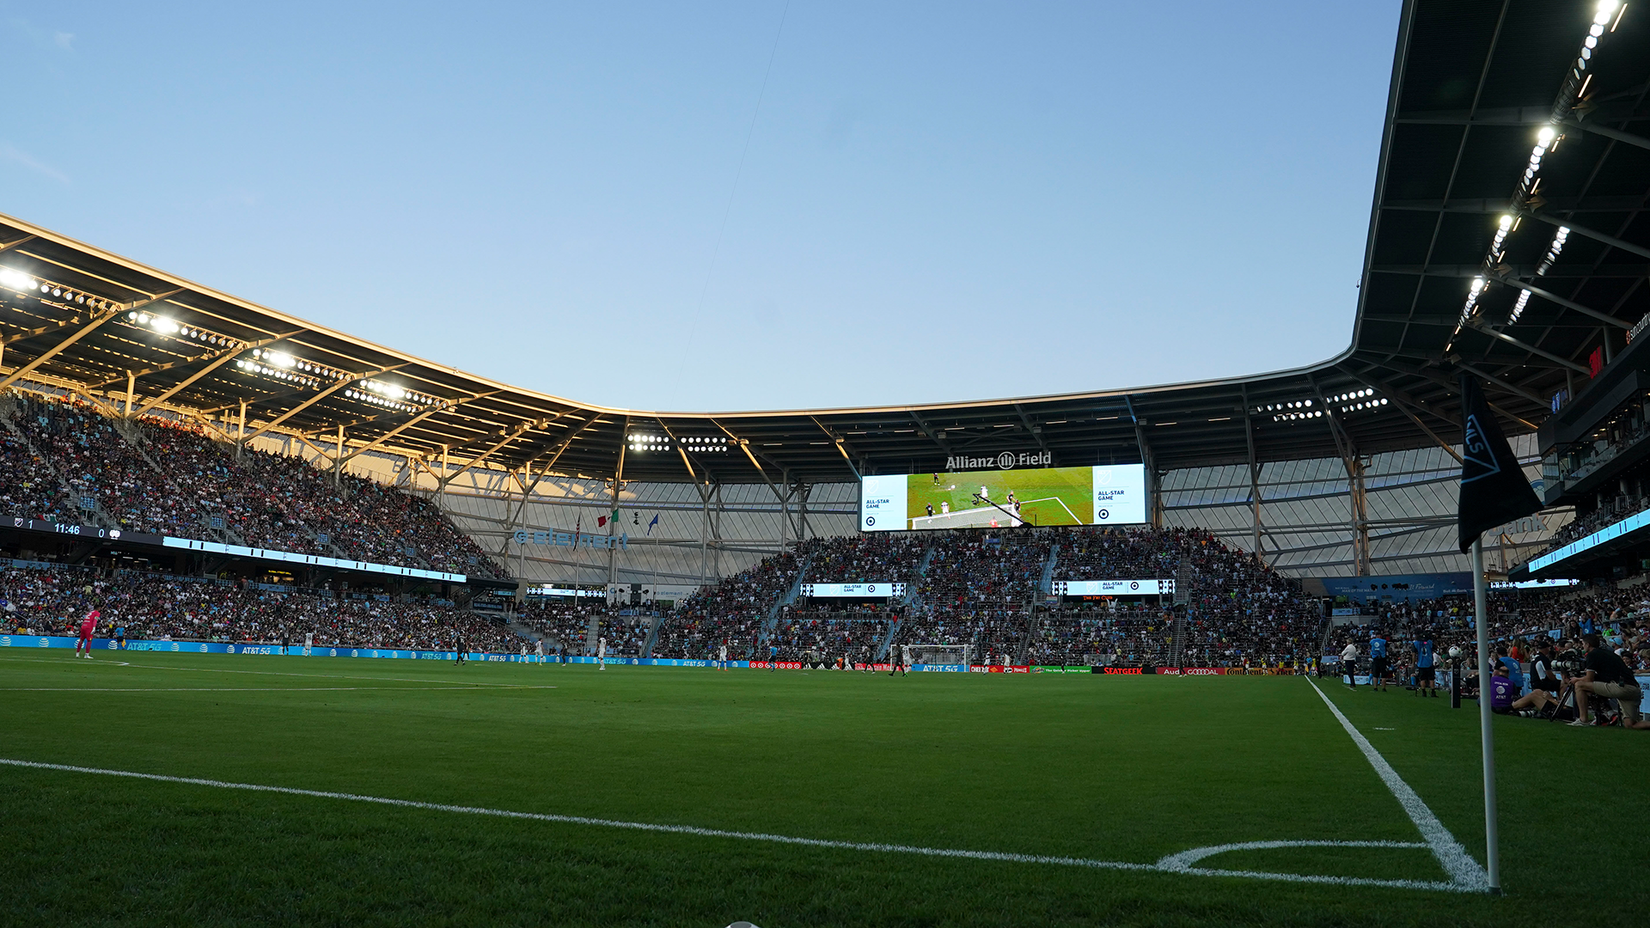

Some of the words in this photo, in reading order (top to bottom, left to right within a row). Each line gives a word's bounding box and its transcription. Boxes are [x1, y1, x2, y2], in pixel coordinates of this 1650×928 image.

[1589, 345, 1603, 379] 3M
[945, 455, 994, 470] Allianz
[1019, 451, 1052, 466] Field
[28, 520, 33, 529] 1
[55, 523, 80, 535] 11:46
[98, 528, 105, 538] 0
[533, 528, 630, 550] element
[127, 642, 148, 651] AT&T
[149, 643, 162, 652] 5G
[242, 647, 259, 655] AT&T
[260, 647, 271, 655] 5G
[1104, 667, 1143, 675] SEATGEEK
